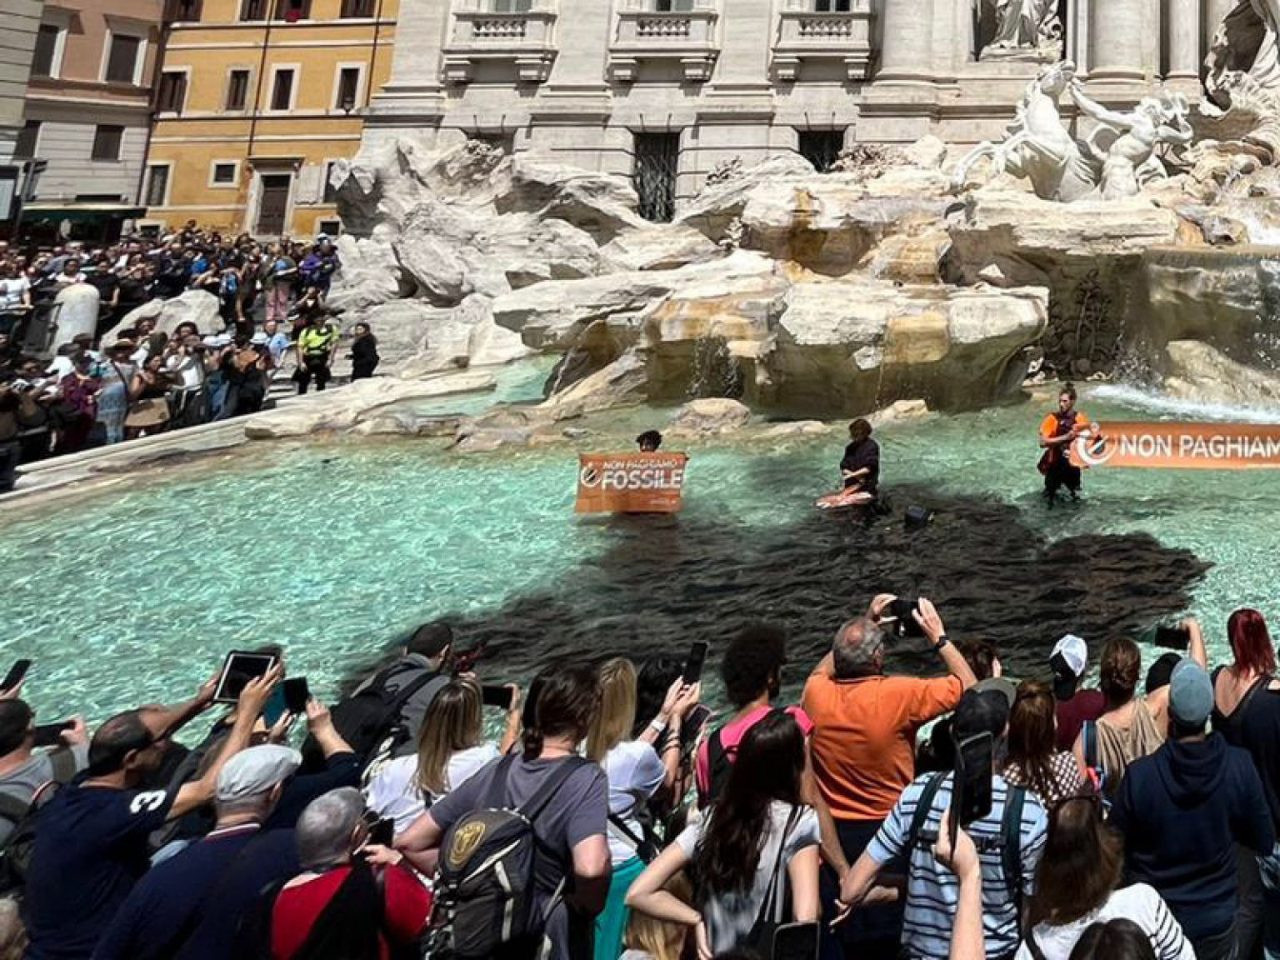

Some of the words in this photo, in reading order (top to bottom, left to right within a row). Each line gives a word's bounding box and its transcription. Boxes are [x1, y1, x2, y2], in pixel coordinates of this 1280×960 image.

[1120, 434, 1173, 457] NON
[602, 469, 683, 490] FOSSILE
[129, 790, 166, 815] 3
